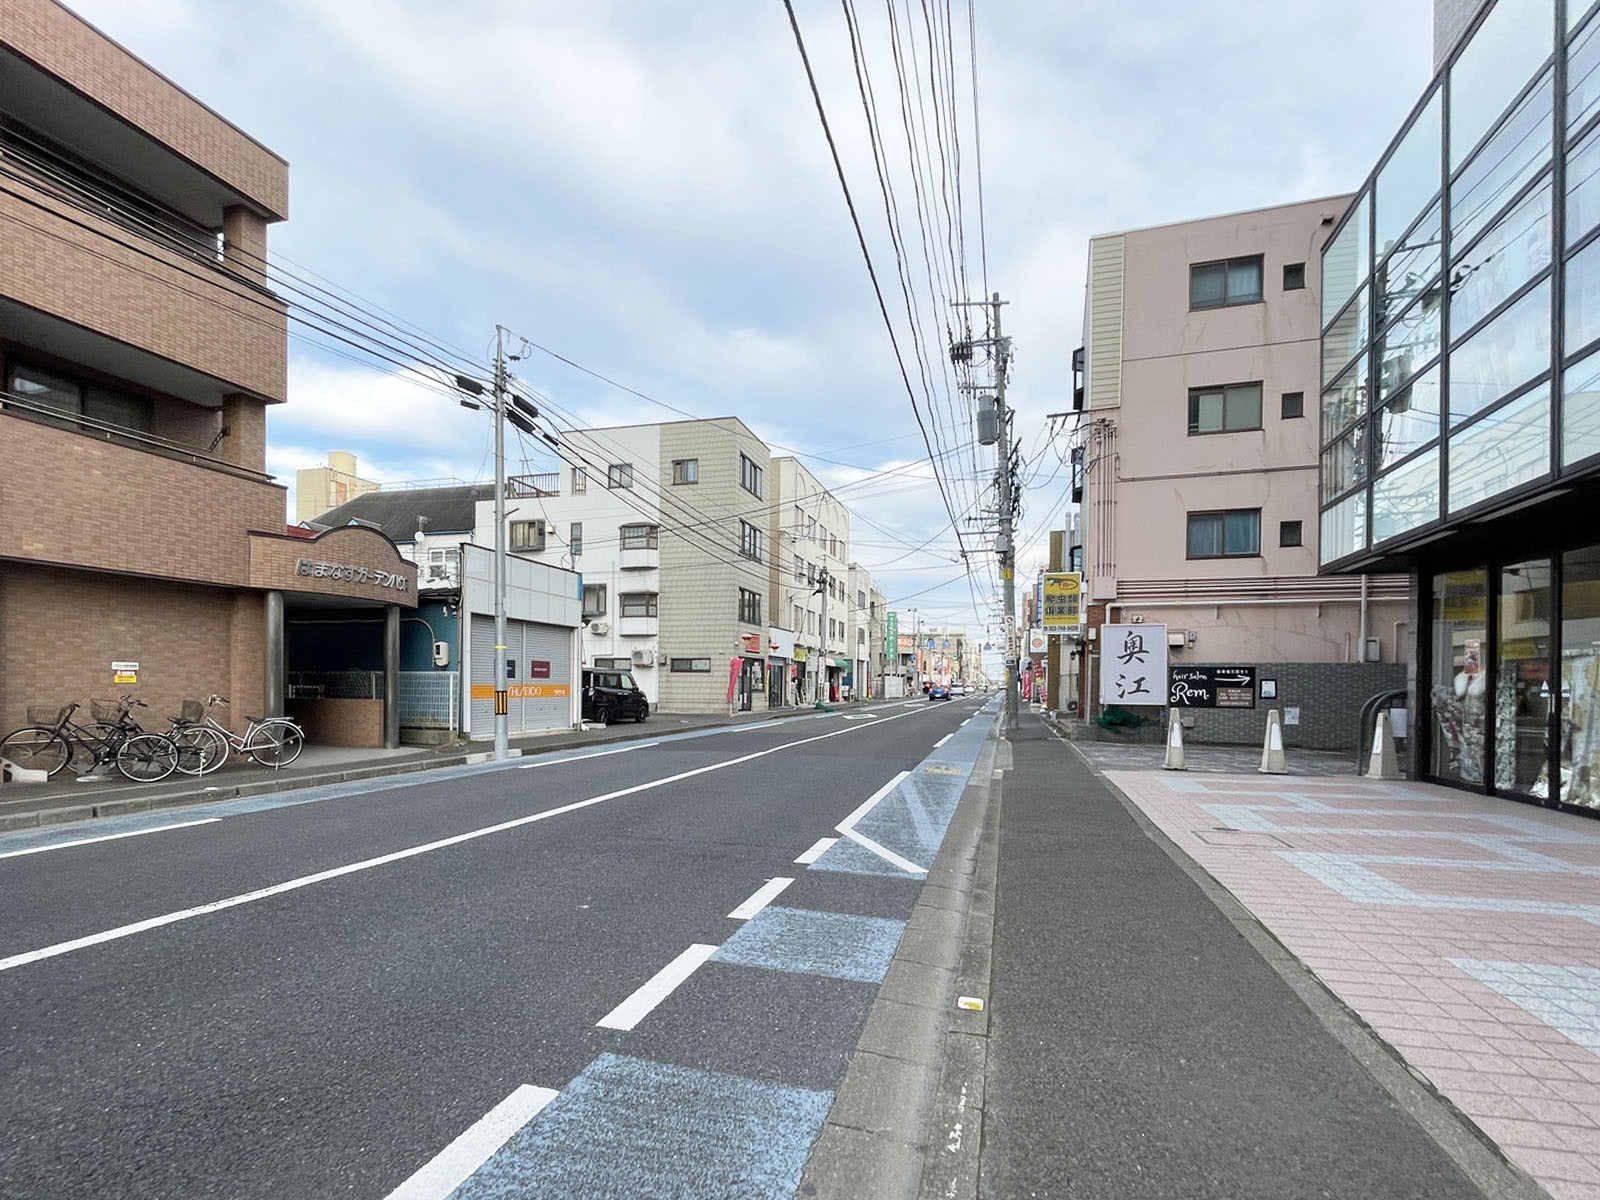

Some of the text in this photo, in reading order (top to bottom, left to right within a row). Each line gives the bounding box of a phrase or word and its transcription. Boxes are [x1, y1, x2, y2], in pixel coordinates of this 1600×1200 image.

[295, 557, 409, 592] はまなすガーデンハウス
[1115, 630, 1150, 699] 奥江
[1172, 669, 1188, 681] hair
[1189, 670, 1208, 681] salon
